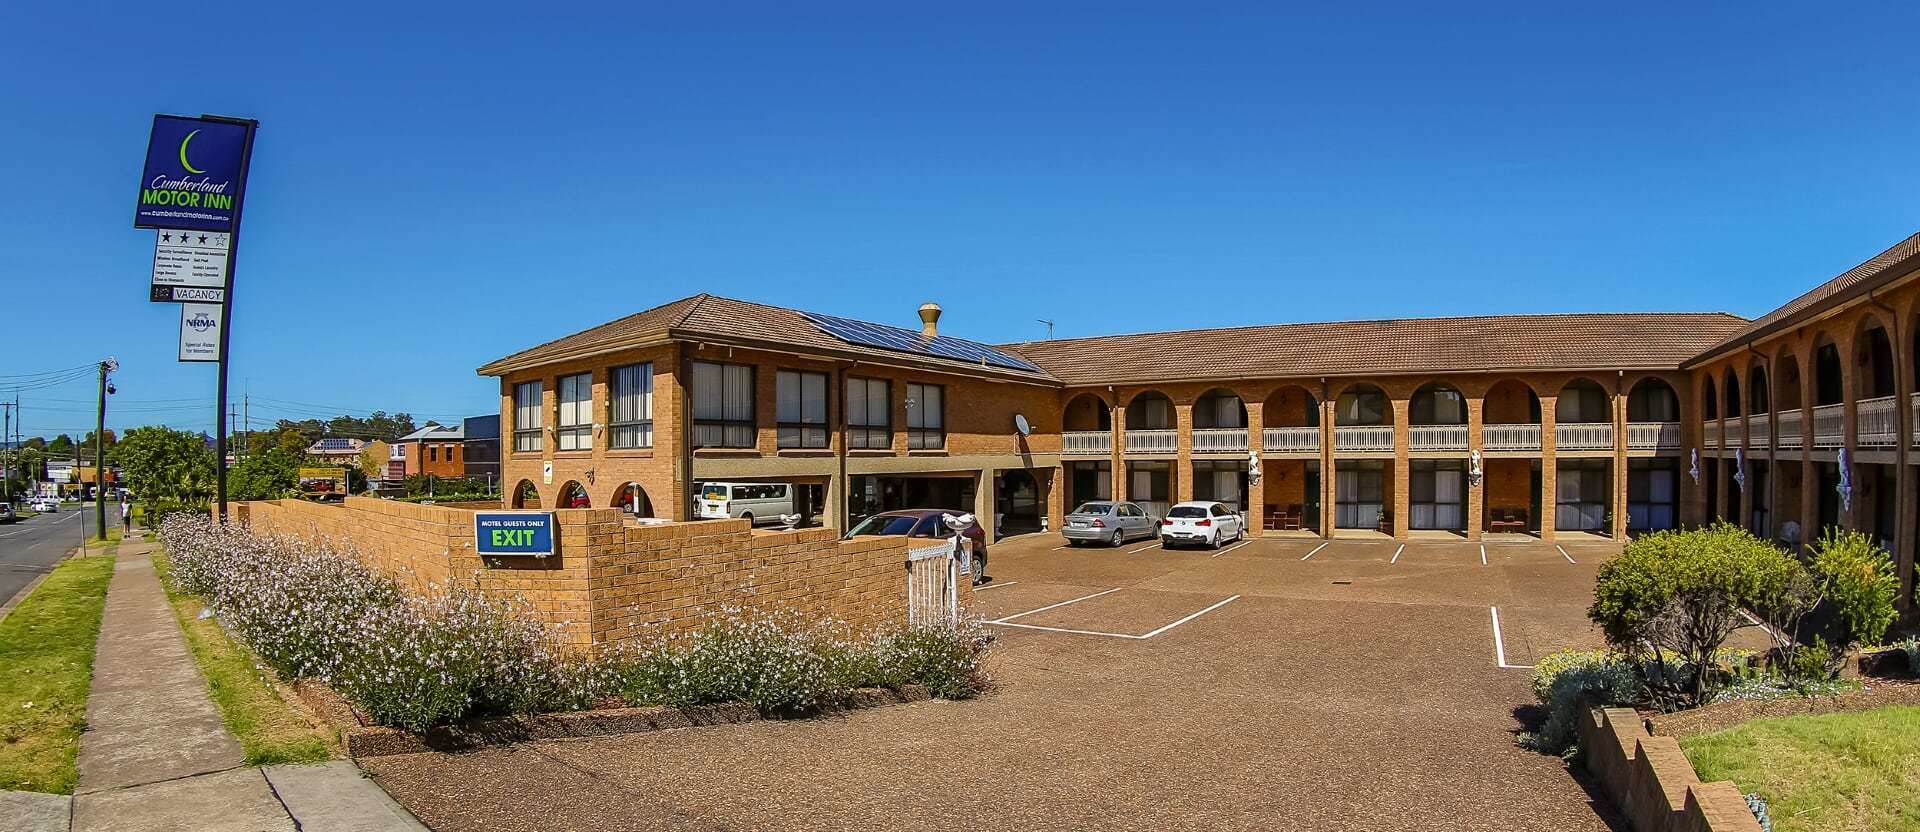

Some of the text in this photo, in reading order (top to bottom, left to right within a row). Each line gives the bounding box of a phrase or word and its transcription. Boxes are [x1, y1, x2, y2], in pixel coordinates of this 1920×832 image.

[151, 175, 228, 193] Cumberland
[143, 190, 231, 209] MOTOR INN
[176, 289, 221, 300] VACANCY
[185, 319, 216, 328] NRMA
[492, 529, 535, 546] EXIT
